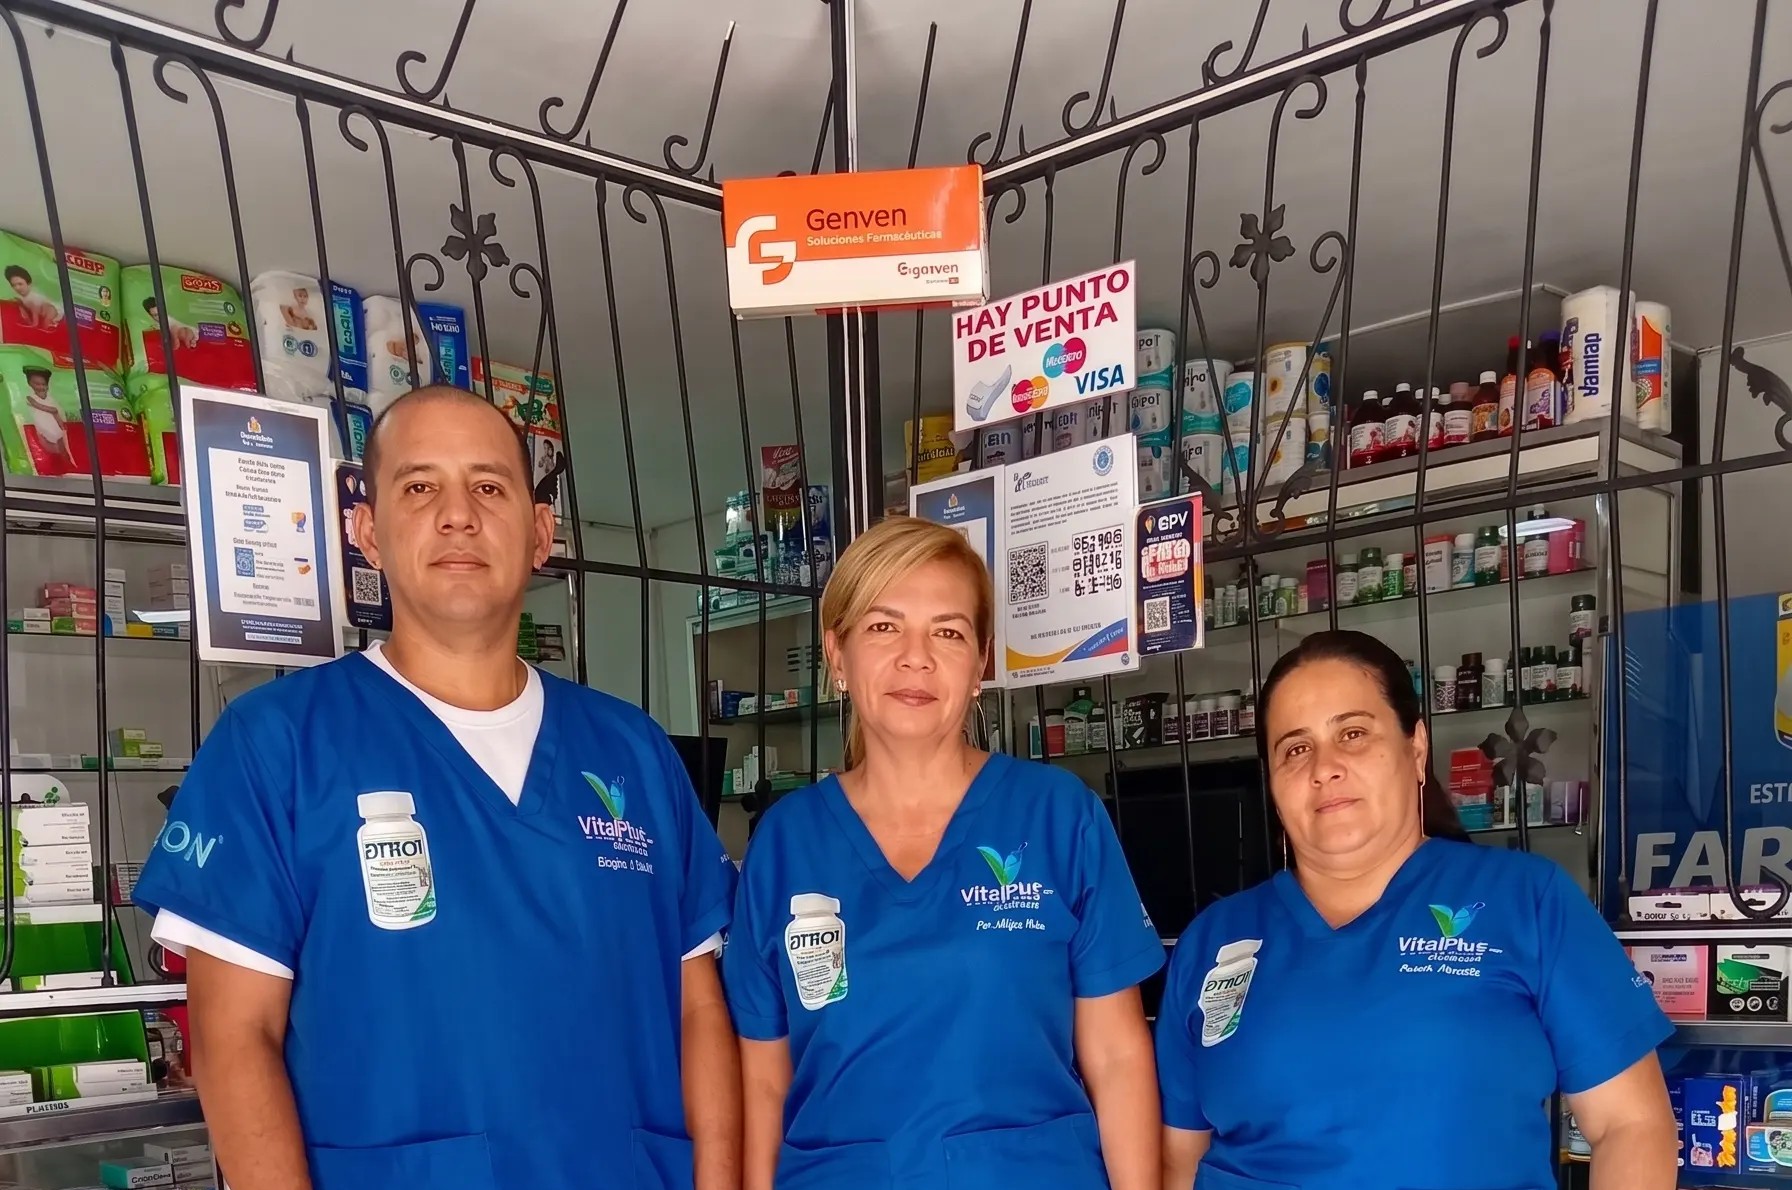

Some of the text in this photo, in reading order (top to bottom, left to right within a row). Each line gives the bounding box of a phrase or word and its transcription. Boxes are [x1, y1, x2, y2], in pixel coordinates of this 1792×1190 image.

[806, 208, 907, 231] Genven
[806, 233, 864, 247] Soluciones
[956, 269, 1130, 339] HAY PUNTO
[968, 301, 1118, 363] DE VENTA
[1074, 364, 1125, 395] VISA
